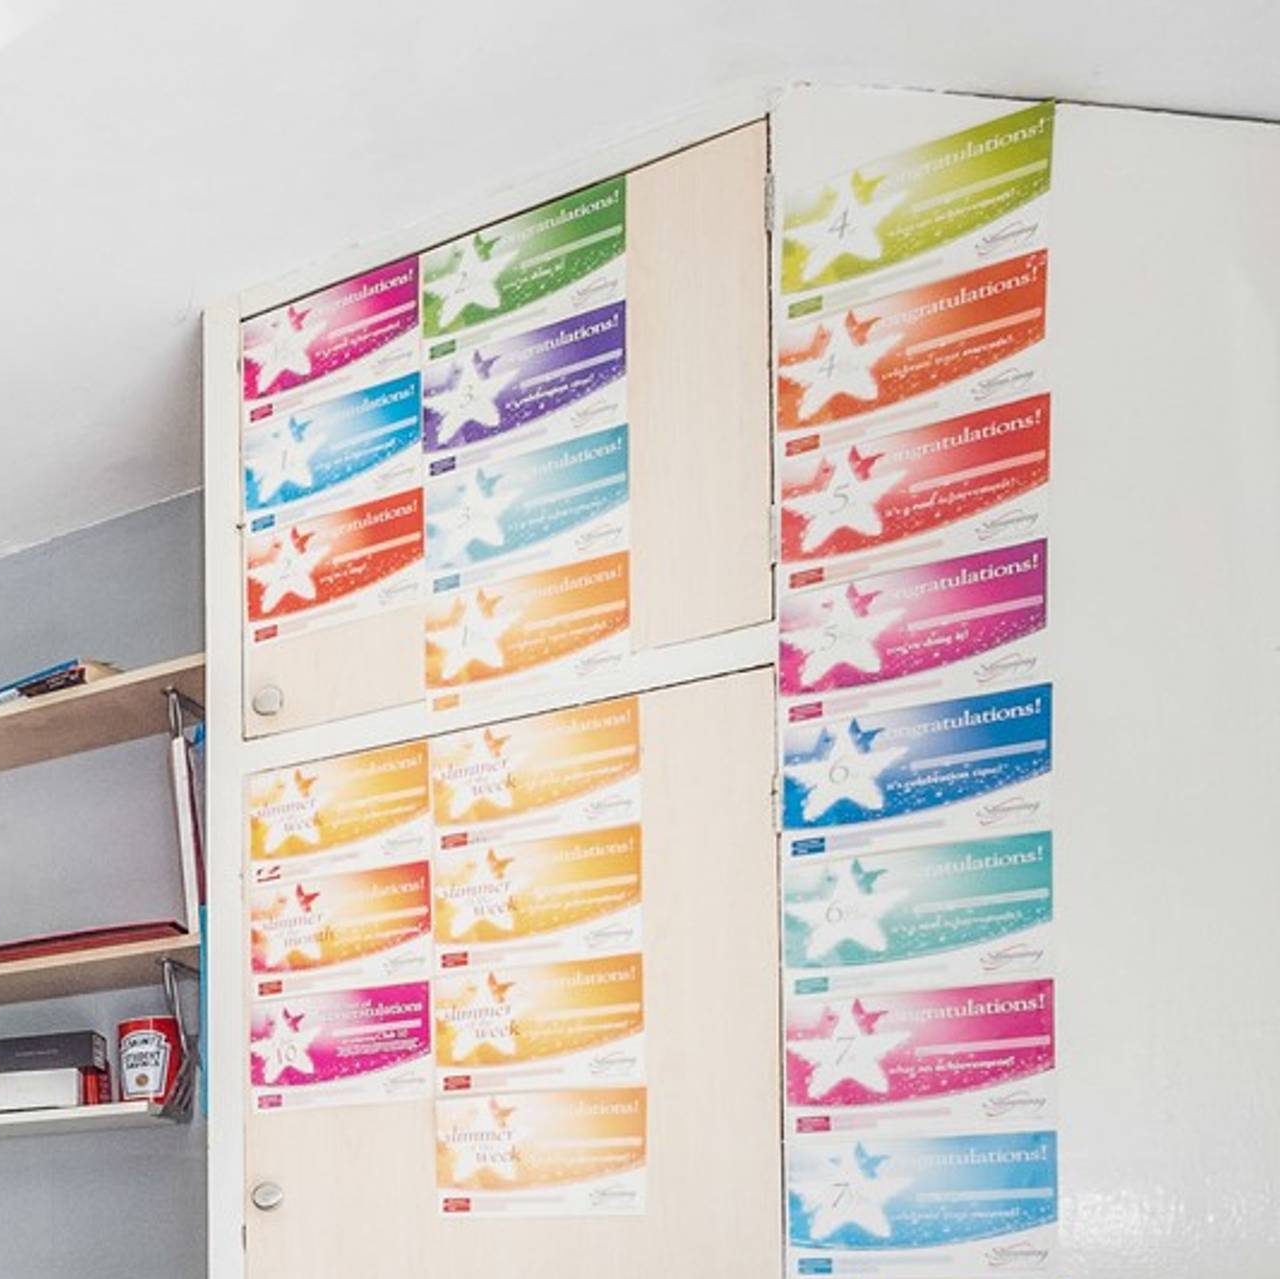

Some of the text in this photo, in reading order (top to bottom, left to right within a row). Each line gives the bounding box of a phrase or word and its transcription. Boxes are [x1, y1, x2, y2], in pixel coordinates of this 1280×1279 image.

[890, 116, 1046, 184] ongratulations!
[508, 190, 620, 243] ngratulations!
[828, 207, 851, 240] 4
[882, 266, 1039, 327] ongratulations!
[510, 314, 619, 358] ngratulations!
[887, 409, 1042, 462] ongratulations!
[830, 483, 849, 515] 5
[892, 554, 1039, 600] ongratulations!
[887, 698, 1042, 738] ongratulations!
[829, 757, 850, 784] 6
[444, 1004, 512, 1022] slimmer
[890, 994, 1046, 1023] ongratulations!
[836, 1036, 856, 1067] 7
[444, 1126, 513, 1144] slimmer
[908, 1145, 1047, 1168] ngratulations!
